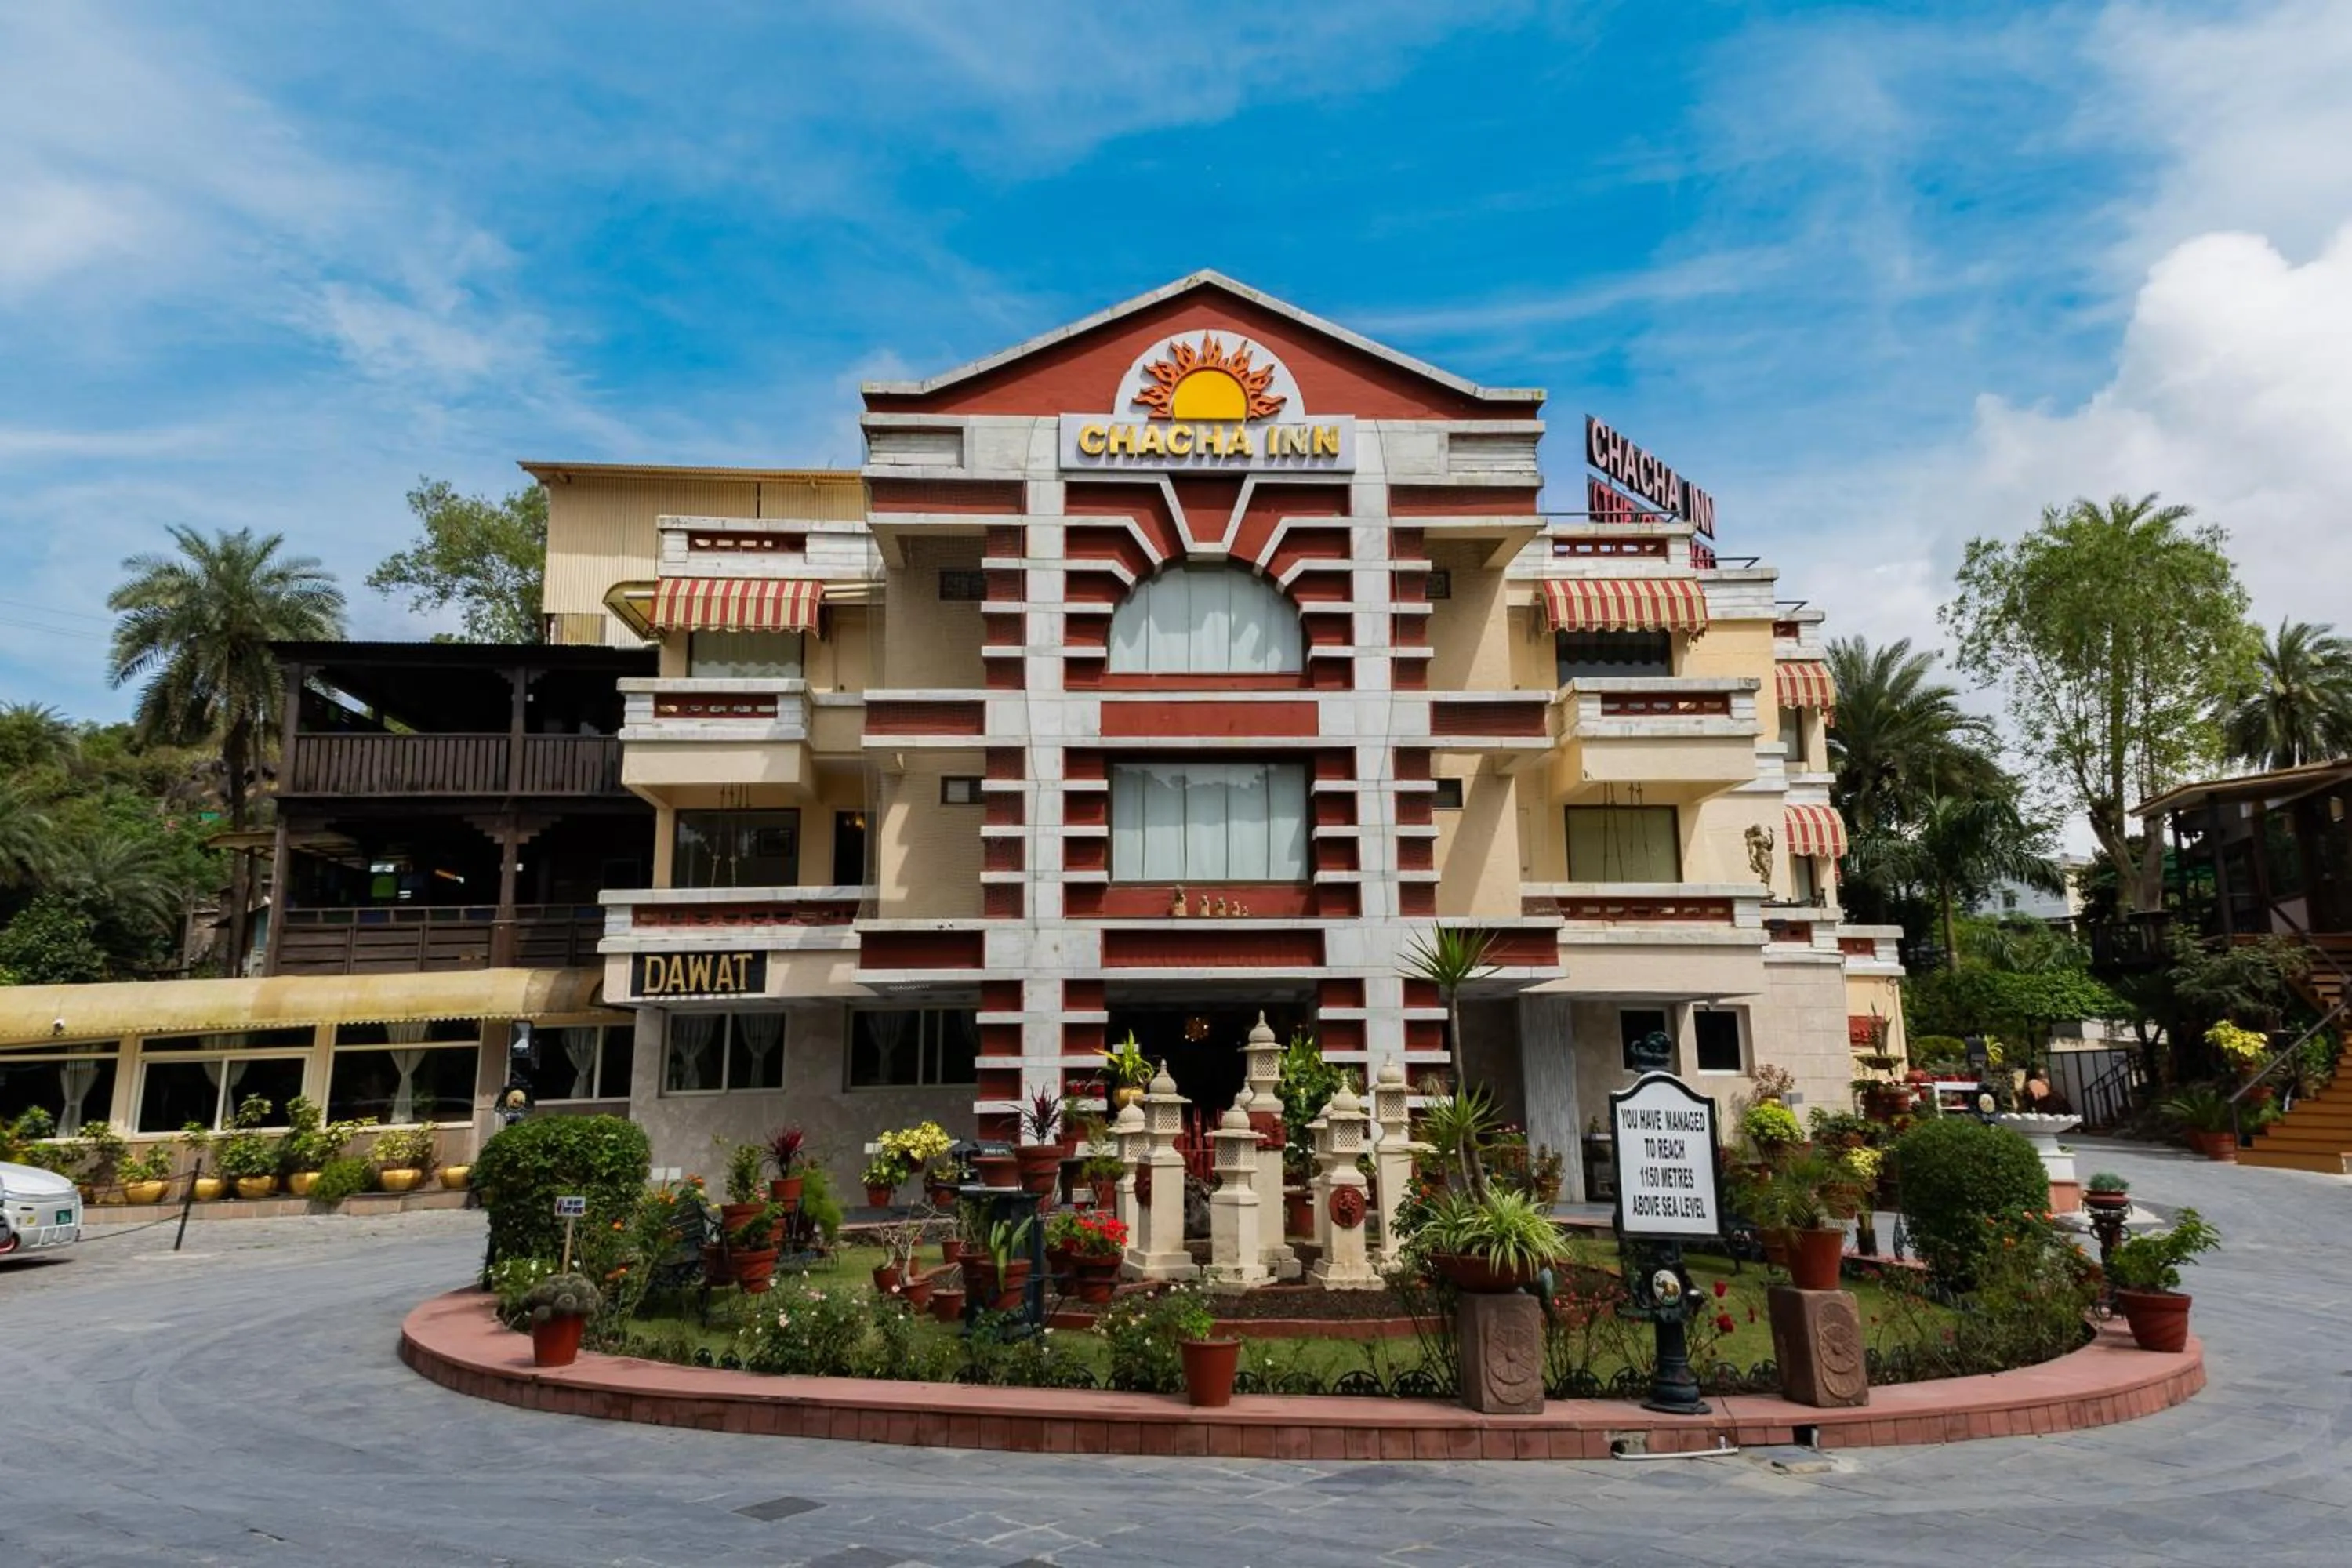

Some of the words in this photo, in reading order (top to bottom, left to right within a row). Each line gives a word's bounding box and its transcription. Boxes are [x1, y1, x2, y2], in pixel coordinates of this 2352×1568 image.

[1079, 423, 1253, 457] CHACHA
[1267, 425, 1340, 456] INN
[1592, 419, 1680, 511] CHACHA
[1689, 482, 1715, 537] INN
[643, 953, 753, 993] DAWAT
[1621, 1108, 1638, 1130] YOU
[1639, 1109, 1662, 1131] HAVE
[1665, 1110, 1705, 1132] MANAGED
[1644, 1138, 1655, 1157] TO
[1658, 1138, 1685, 1160] REACH
[1640, 1166, 1659, 1187] 1150
[1661, 1167, 1694, 1189] METRES
[1633, 1195, 1659, 1216] ABOVE
[1661, 1196, 1679, 1217] SEA
[1680, 1196, 1706, 1218] LEVEL
